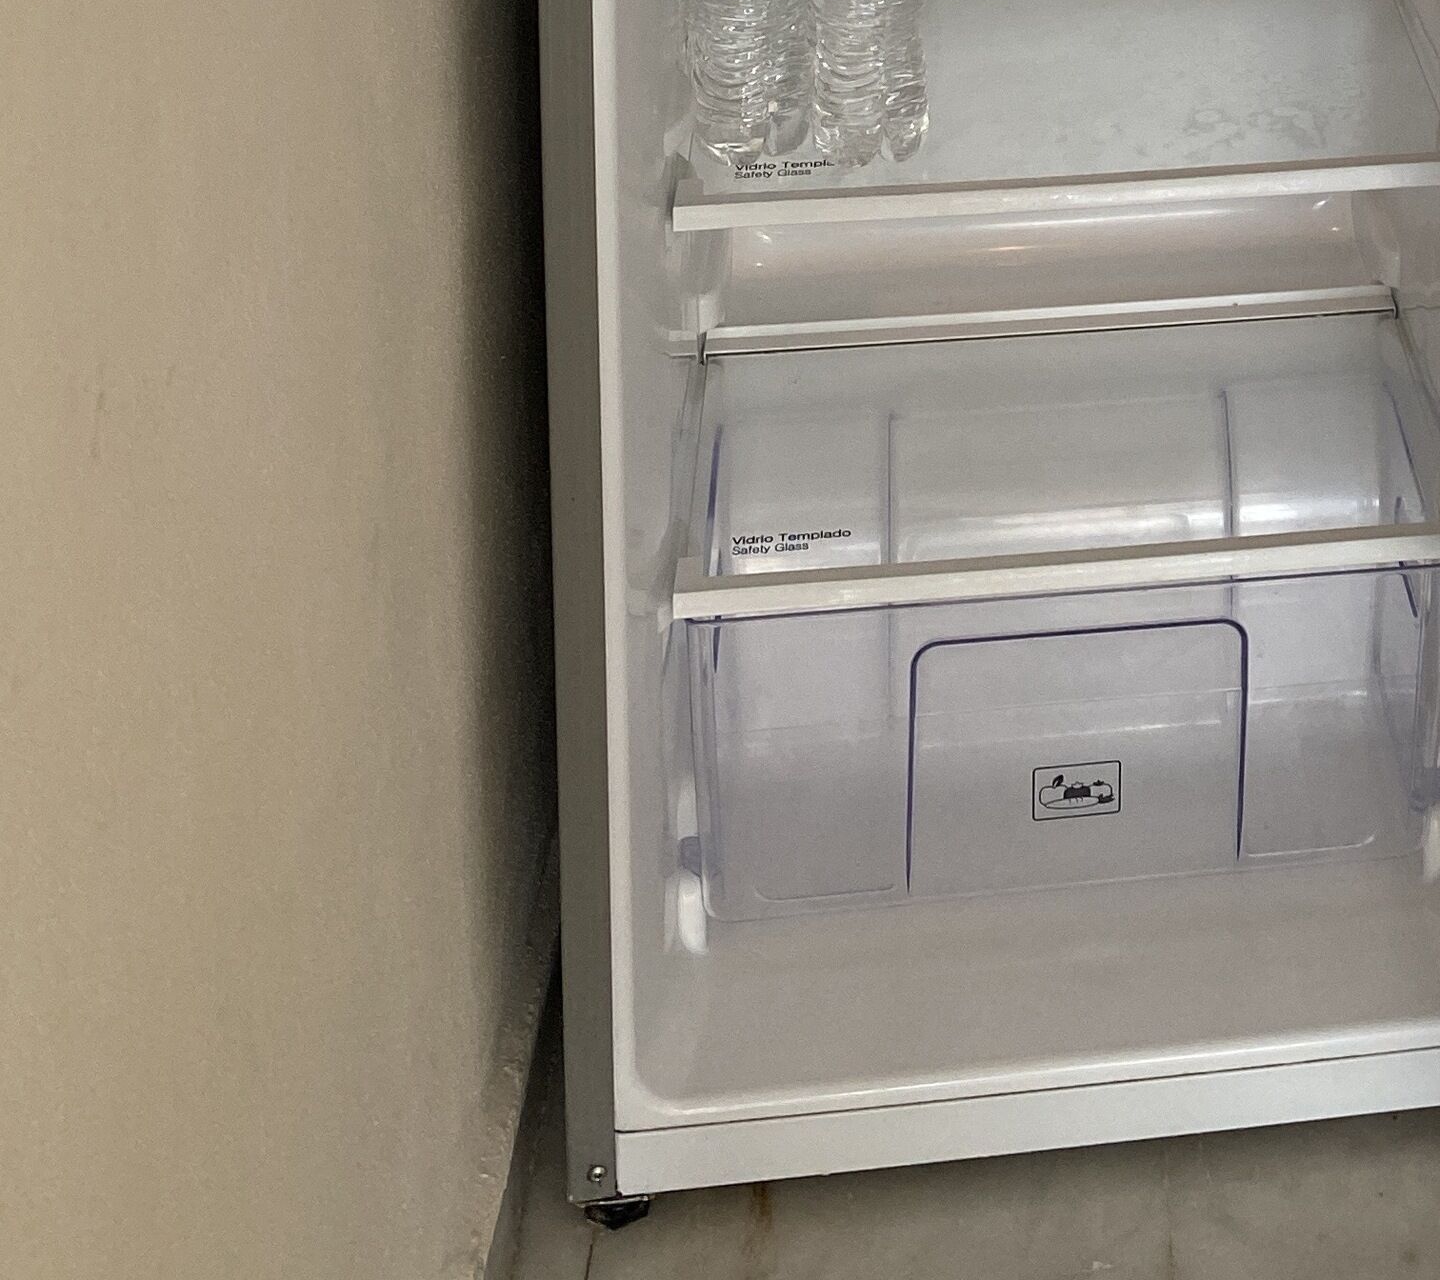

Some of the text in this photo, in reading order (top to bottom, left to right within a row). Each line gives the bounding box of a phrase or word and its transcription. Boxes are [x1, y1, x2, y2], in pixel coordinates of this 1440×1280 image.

[735, 161, 777, 171] Vidrio
[734, 168, 812, 180] Safety Glass
[732, 529, 852, 545] Vidrio Templado
[731, 542, 809, 556] Safety Glass
